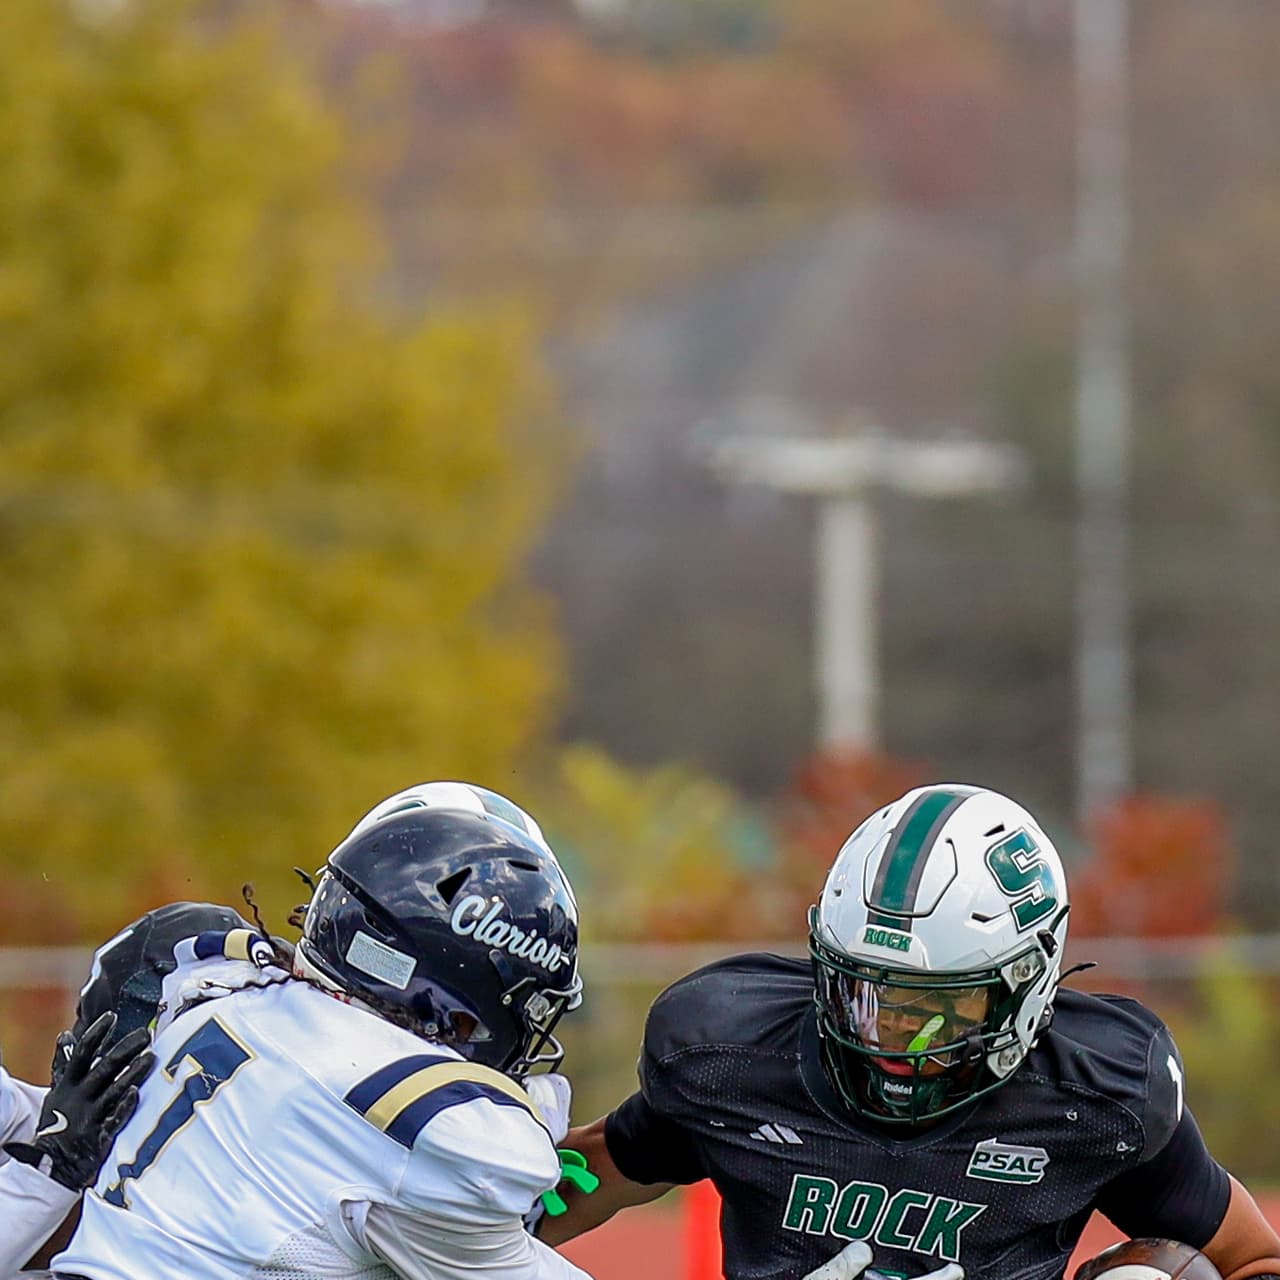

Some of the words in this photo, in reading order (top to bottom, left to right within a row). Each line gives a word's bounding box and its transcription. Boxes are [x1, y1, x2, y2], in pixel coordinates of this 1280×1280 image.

[984, 827, 1058, 934] S
[451, 895, 564, 972] Clarion
[863, 926, 913, 952] ROCK
[99, 1012, 258, 1211] 7
[883, 1081, 913, 1095] Riddel
[971, 1151, 1045, 1173] PSAC
[782, 1174, 988, 1262] ROCK
